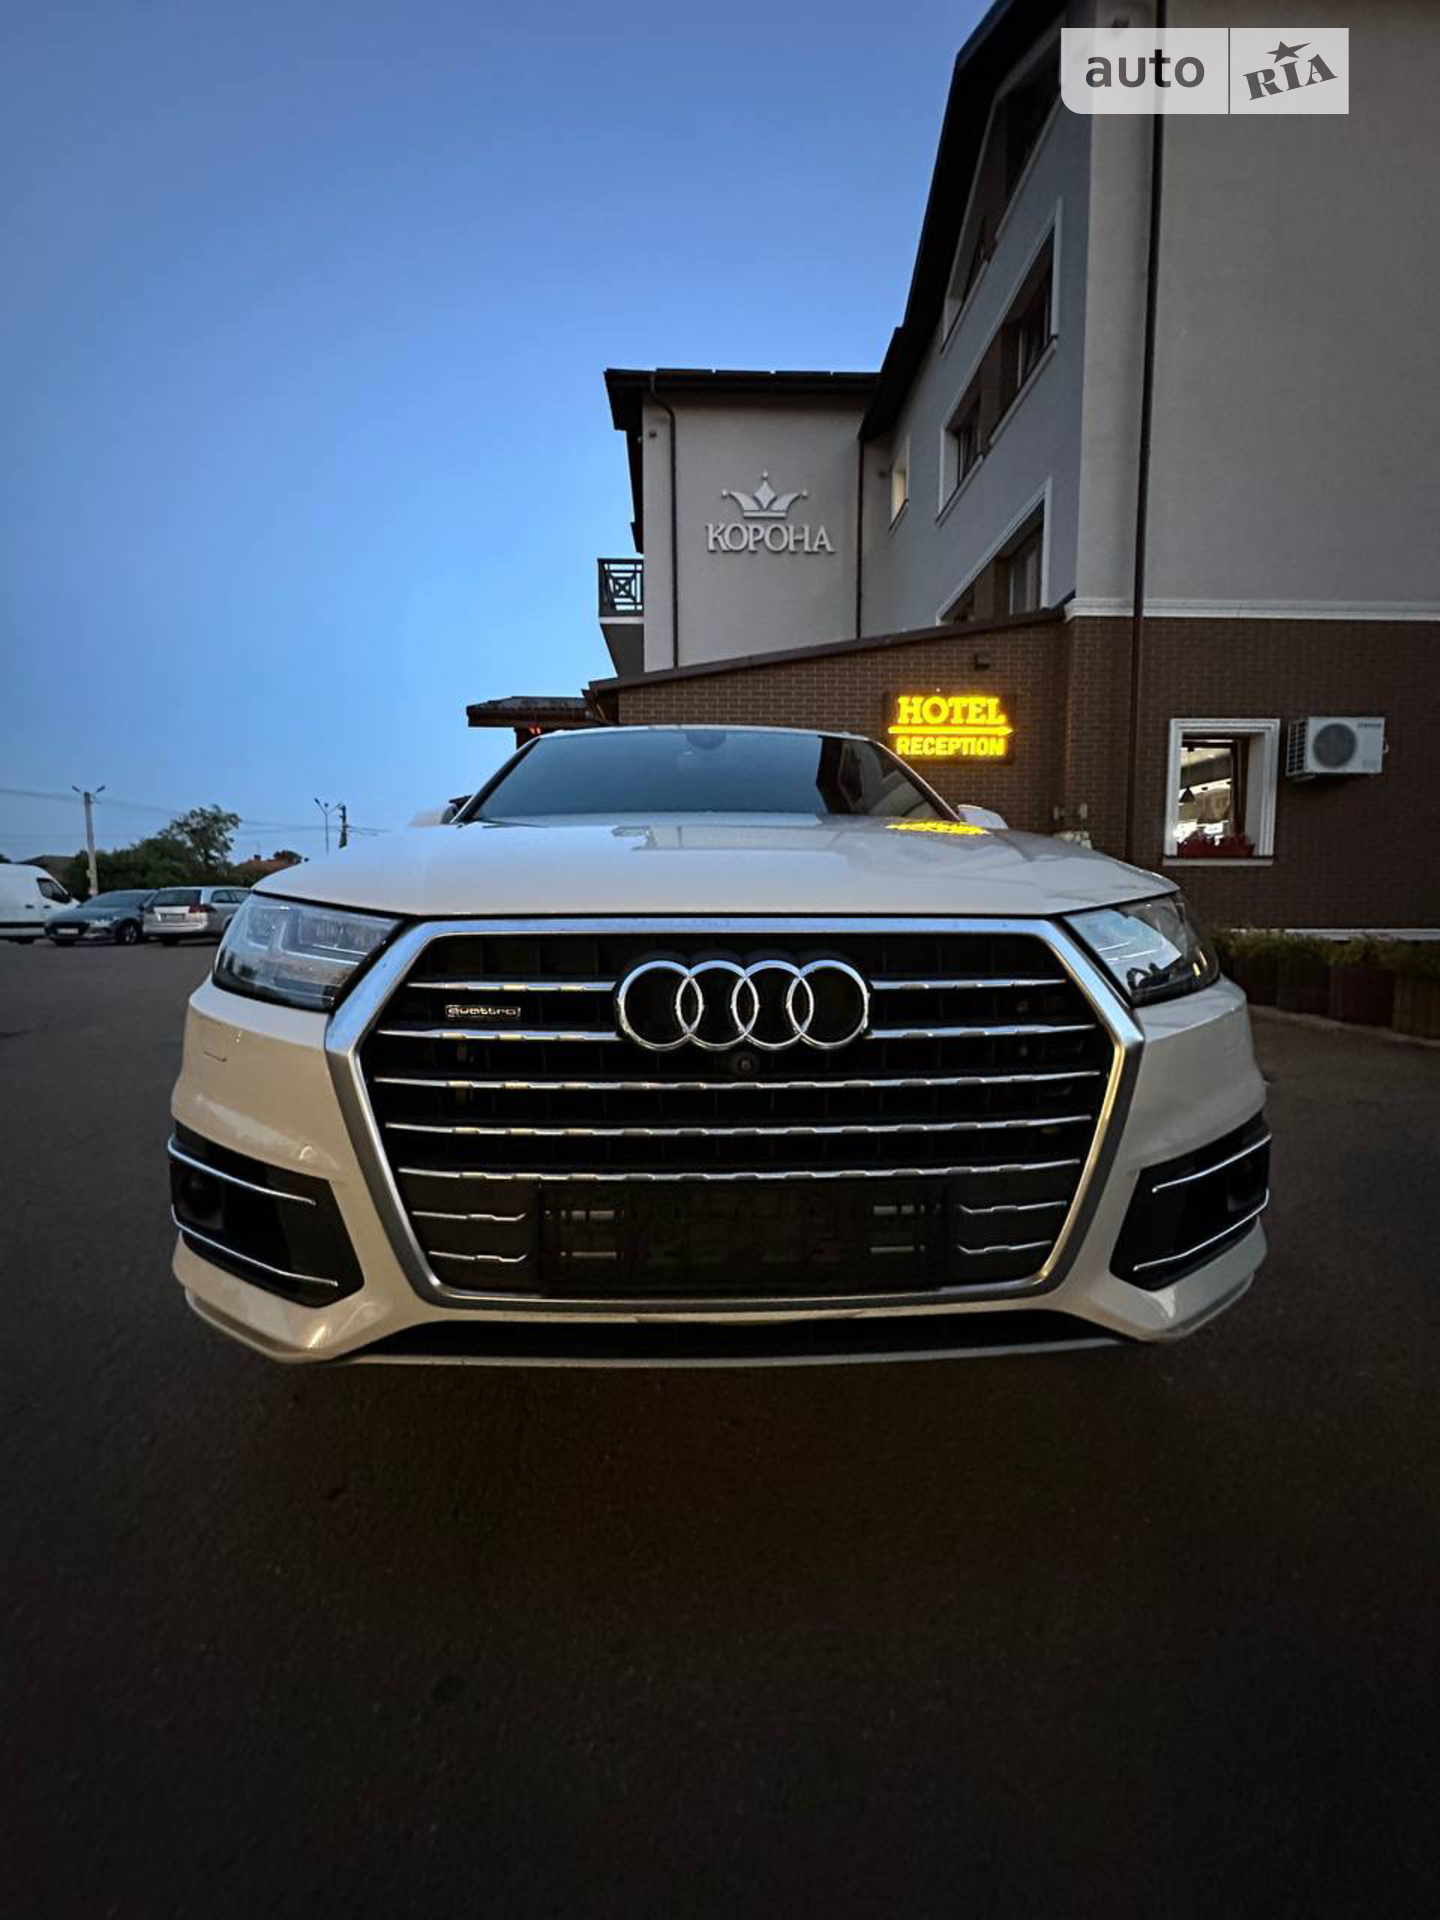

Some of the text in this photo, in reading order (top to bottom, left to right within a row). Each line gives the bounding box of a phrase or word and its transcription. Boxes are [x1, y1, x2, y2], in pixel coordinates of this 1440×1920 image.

[706, 523, 836, 553] КОРОНА
[898, 696, 1006, 724] HOTEL
[896, 736, 1006, 756] RECEPTION
